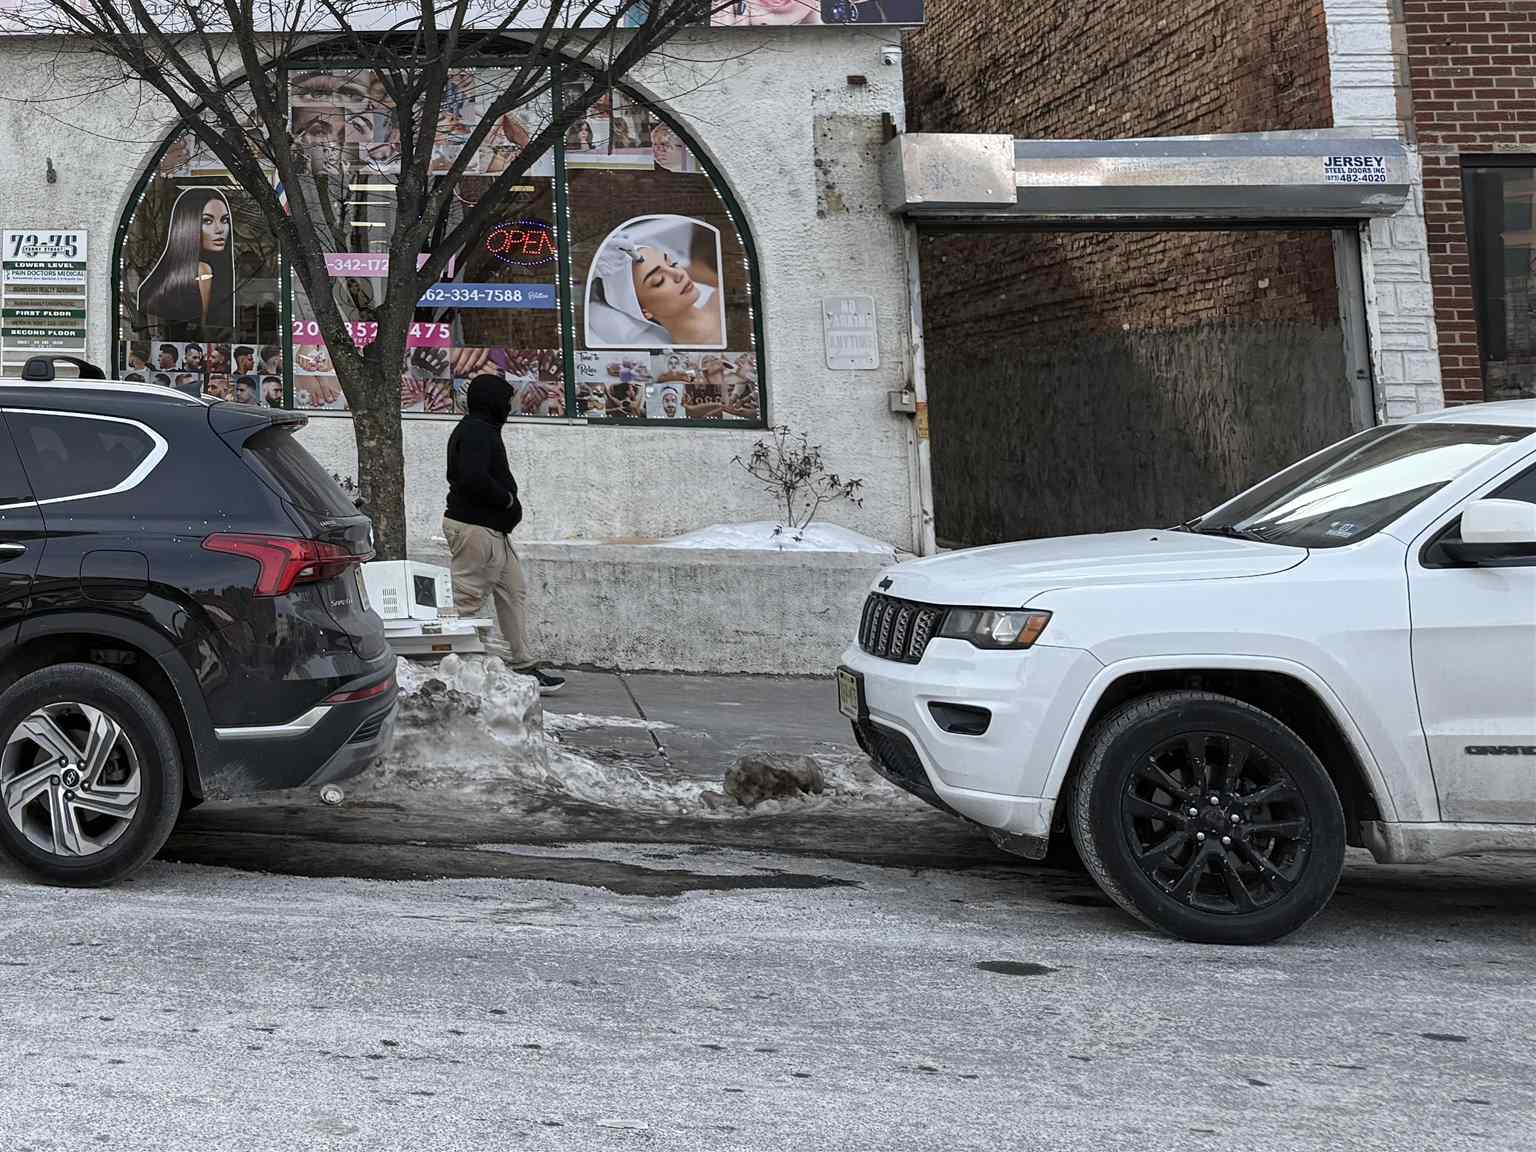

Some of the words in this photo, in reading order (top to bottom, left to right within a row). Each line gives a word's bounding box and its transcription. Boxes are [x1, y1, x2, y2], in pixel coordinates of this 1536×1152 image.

[1324, 156, 1383, 167] JERSEY
[10, 234, 78, 258] 73-75
[486, 228, 558, 256] OPEN
